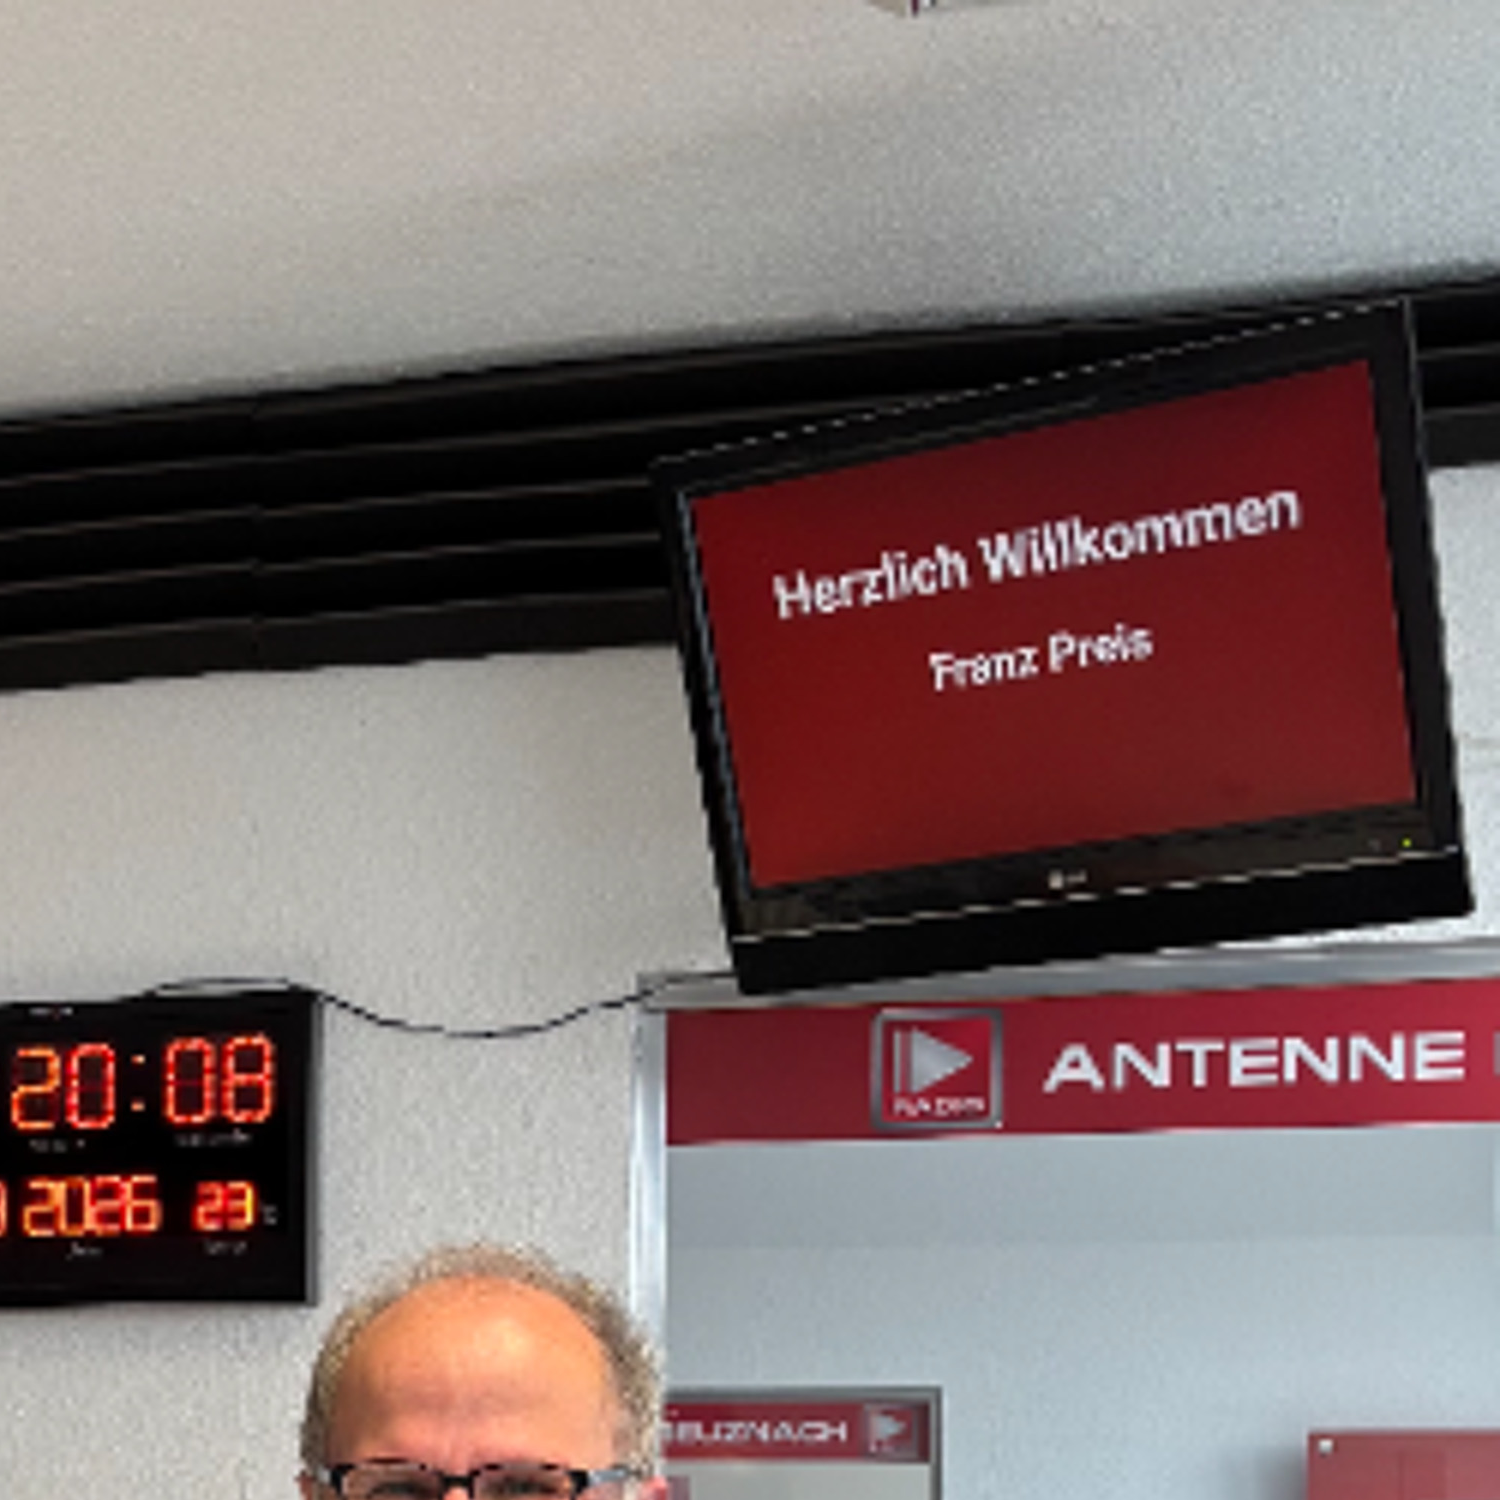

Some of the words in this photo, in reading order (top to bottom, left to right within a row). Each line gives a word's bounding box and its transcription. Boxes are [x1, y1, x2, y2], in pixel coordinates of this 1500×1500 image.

[773, 544, 969, 619] Herzlich
[977, 489, 1299, 582] Willkommen
[928, 648, 1040, 691] Franz
[1048, 622, 1154, 672] Preis
[1042, 1030, 1466, 1094] ANTENNE
